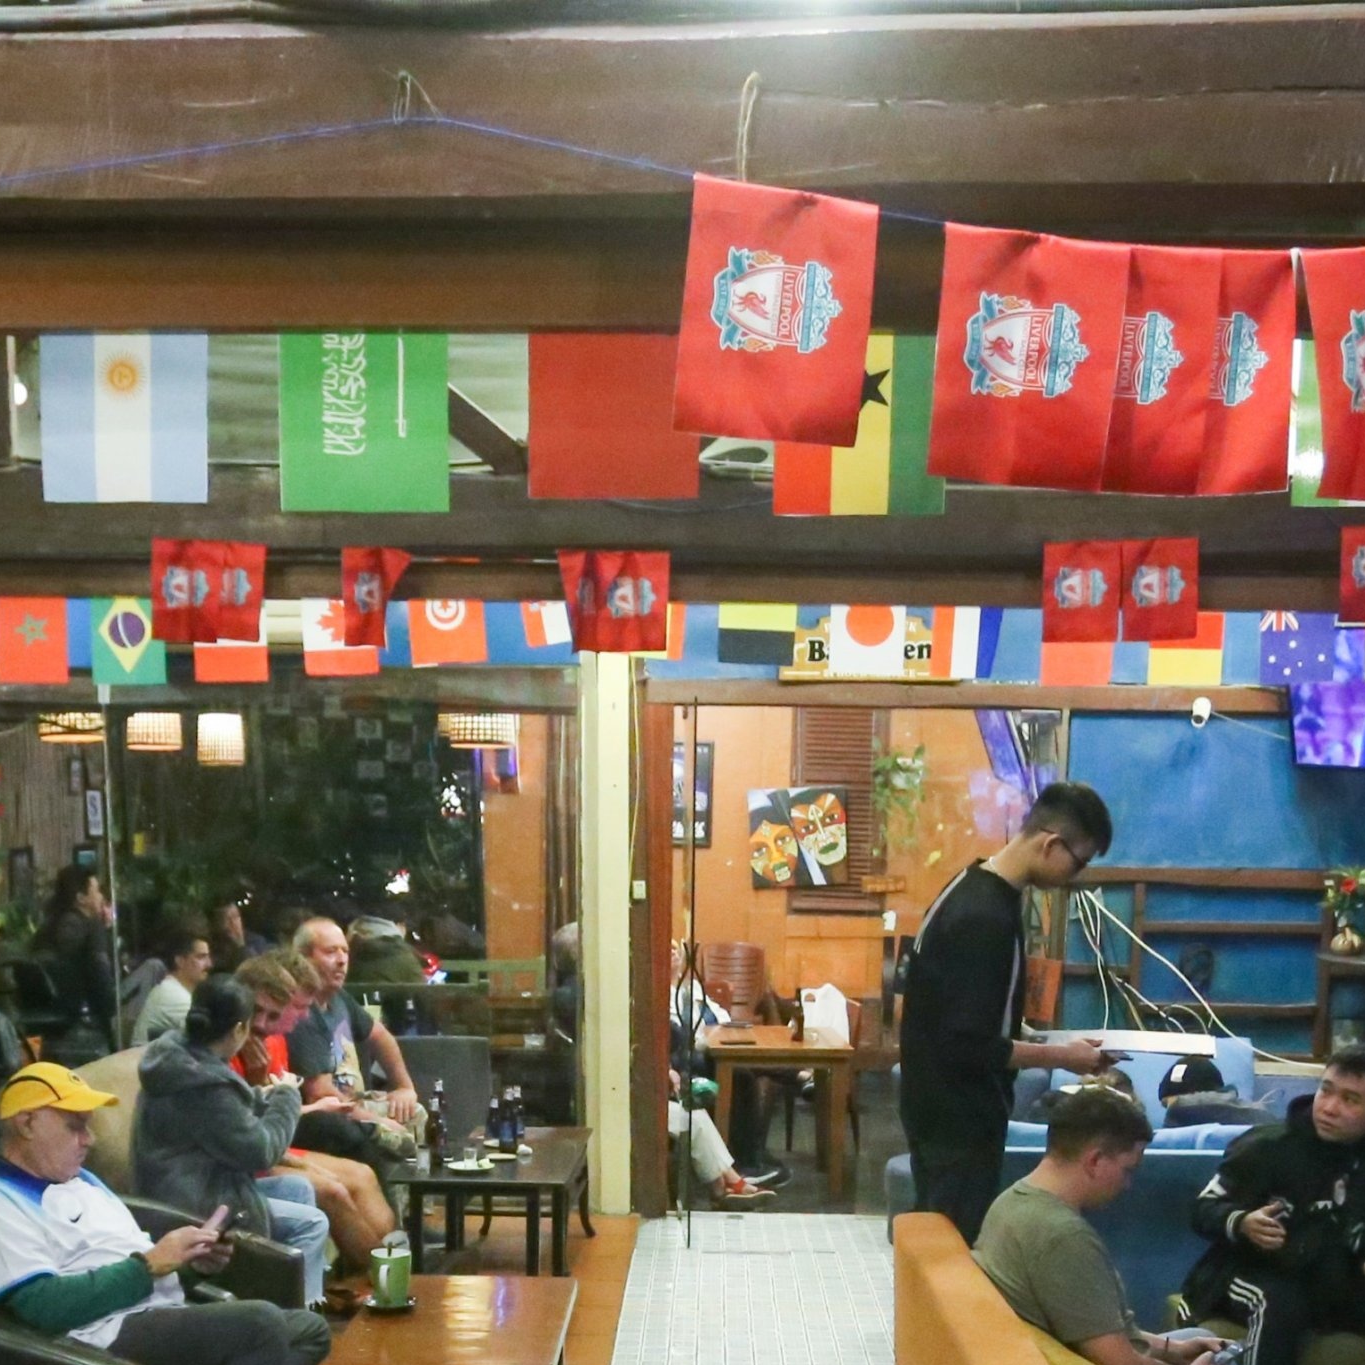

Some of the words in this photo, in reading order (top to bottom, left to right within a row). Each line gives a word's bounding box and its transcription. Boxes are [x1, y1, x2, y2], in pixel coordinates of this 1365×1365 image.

[778, 272, 796, 337] LIVERPOOL
[1025, 316, 1043, 383] LIVERPOOL
[1120, 324, 1137, 388] LIVERPOOL
